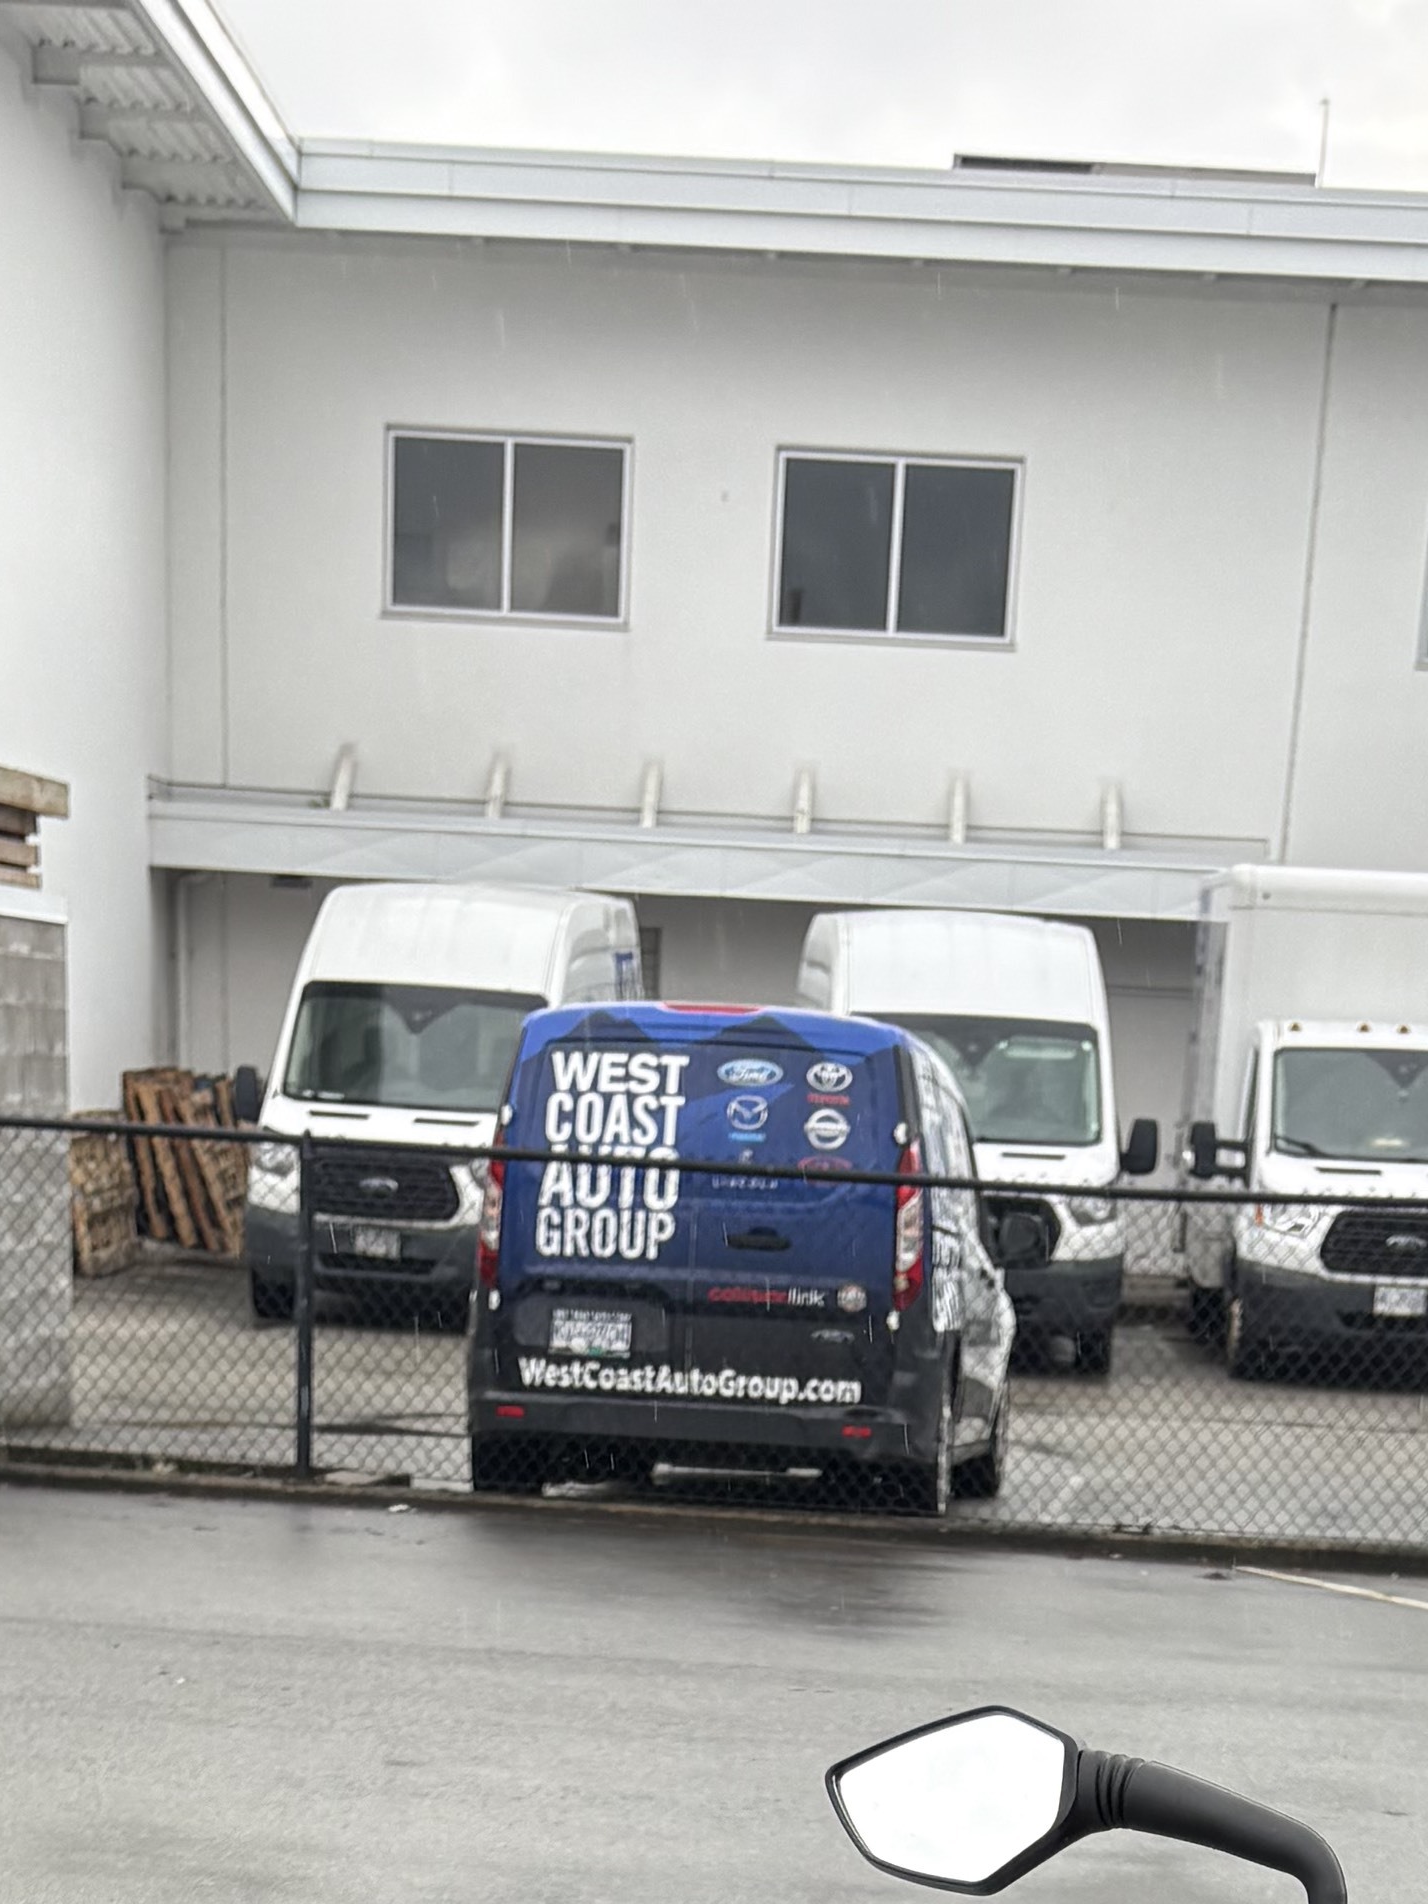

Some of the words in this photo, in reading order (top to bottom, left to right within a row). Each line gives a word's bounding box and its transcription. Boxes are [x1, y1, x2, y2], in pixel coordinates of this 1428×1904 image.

[551, 1050, 690, 1095] WEST
[544, 1091, 686, 1146] COAST
[538, 1144, 680, 1211] AUTO
[535, 1204, 676, 1261] GROUP
[518, 1354, 863, 1405] WestCoastAutoGroup.com
